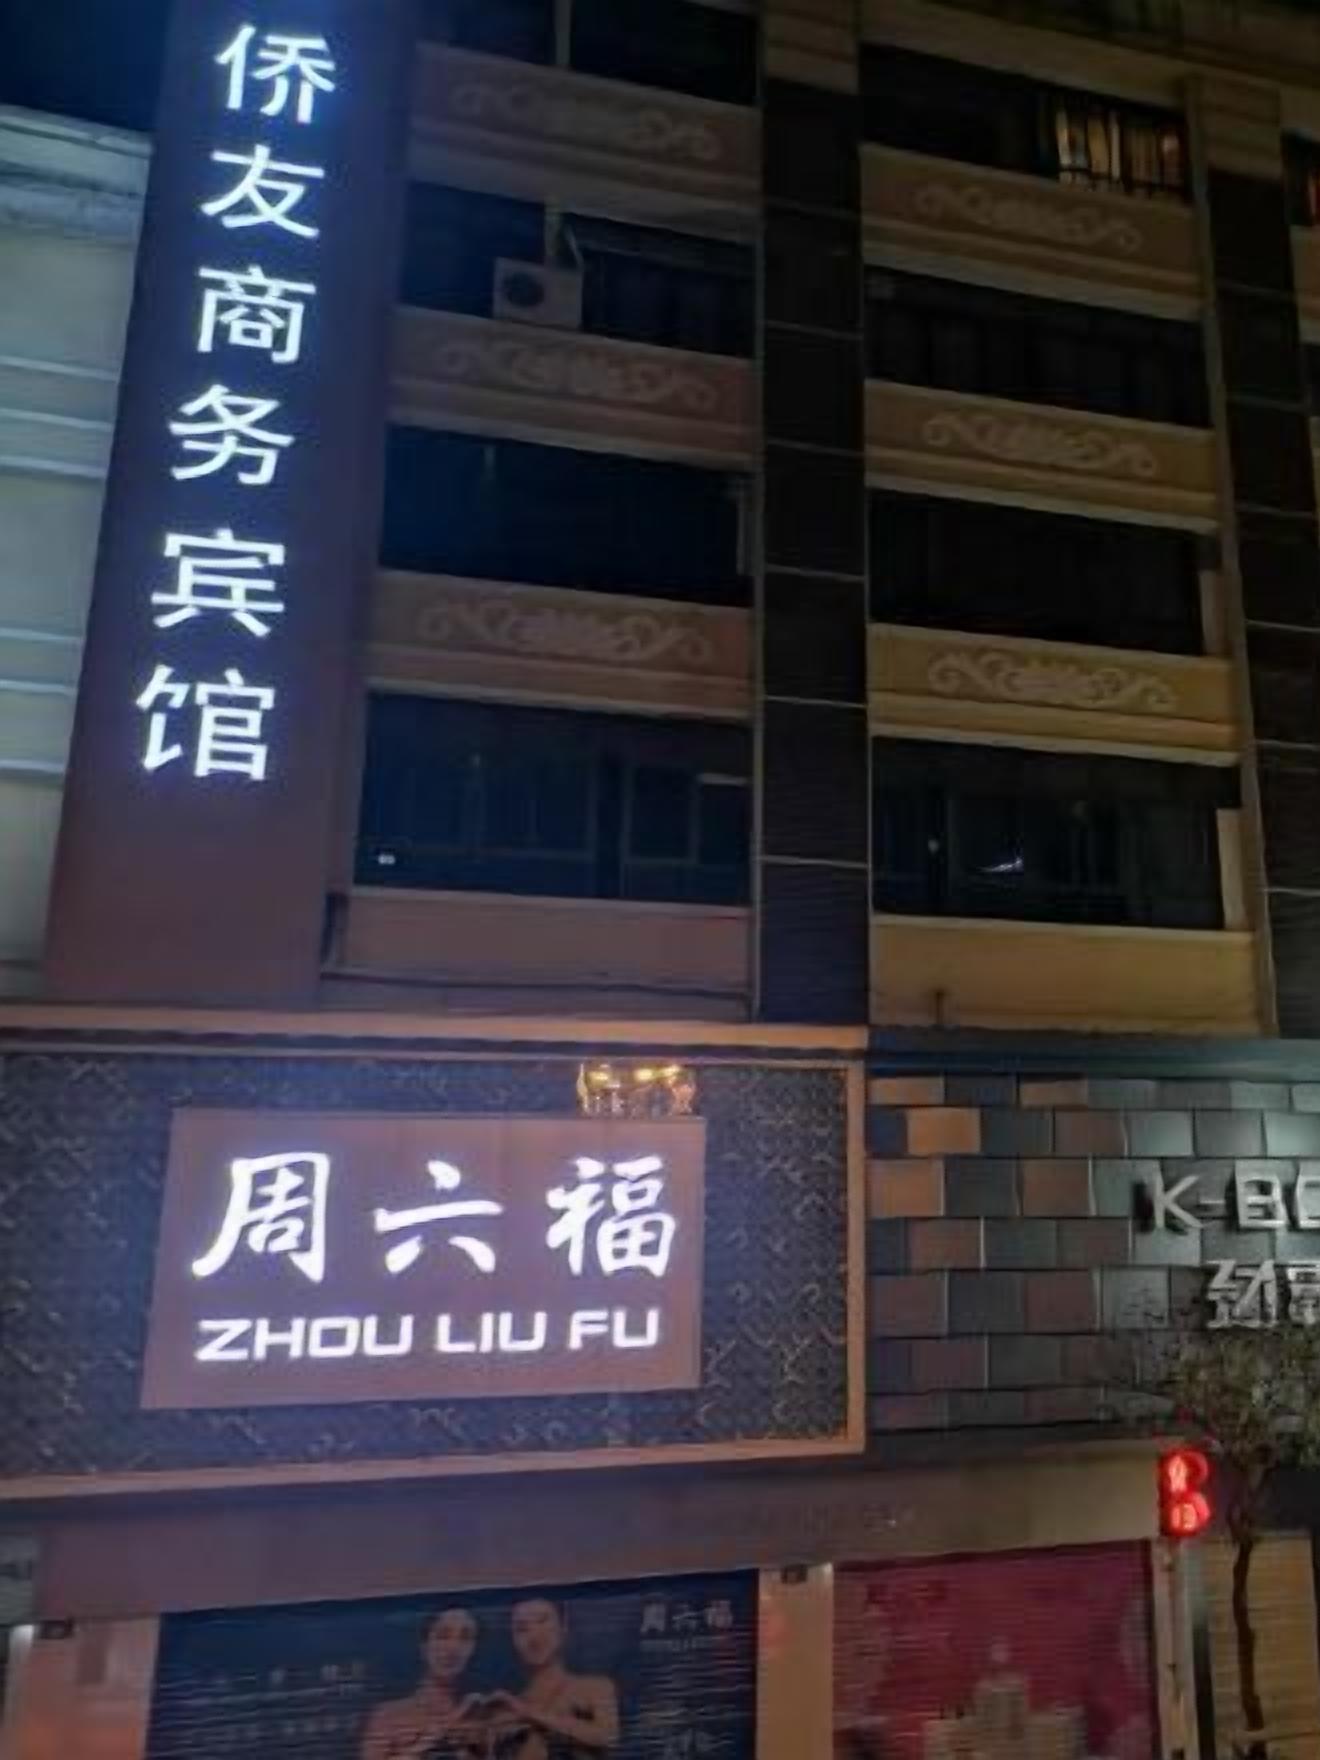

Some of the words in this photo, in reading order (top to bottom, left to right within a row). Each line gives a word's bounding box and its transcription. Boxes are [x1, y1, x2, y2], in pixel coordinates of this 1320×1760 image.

[136, 23, 336, 781] 侨友商务宾馆
[190, 1151, 678, 1282] 周六福
[194, 1313, 413, 1361] ZHOU
[434, 1311, 548, 1354] LIU
[568, 1307, 661, 1350] FU
